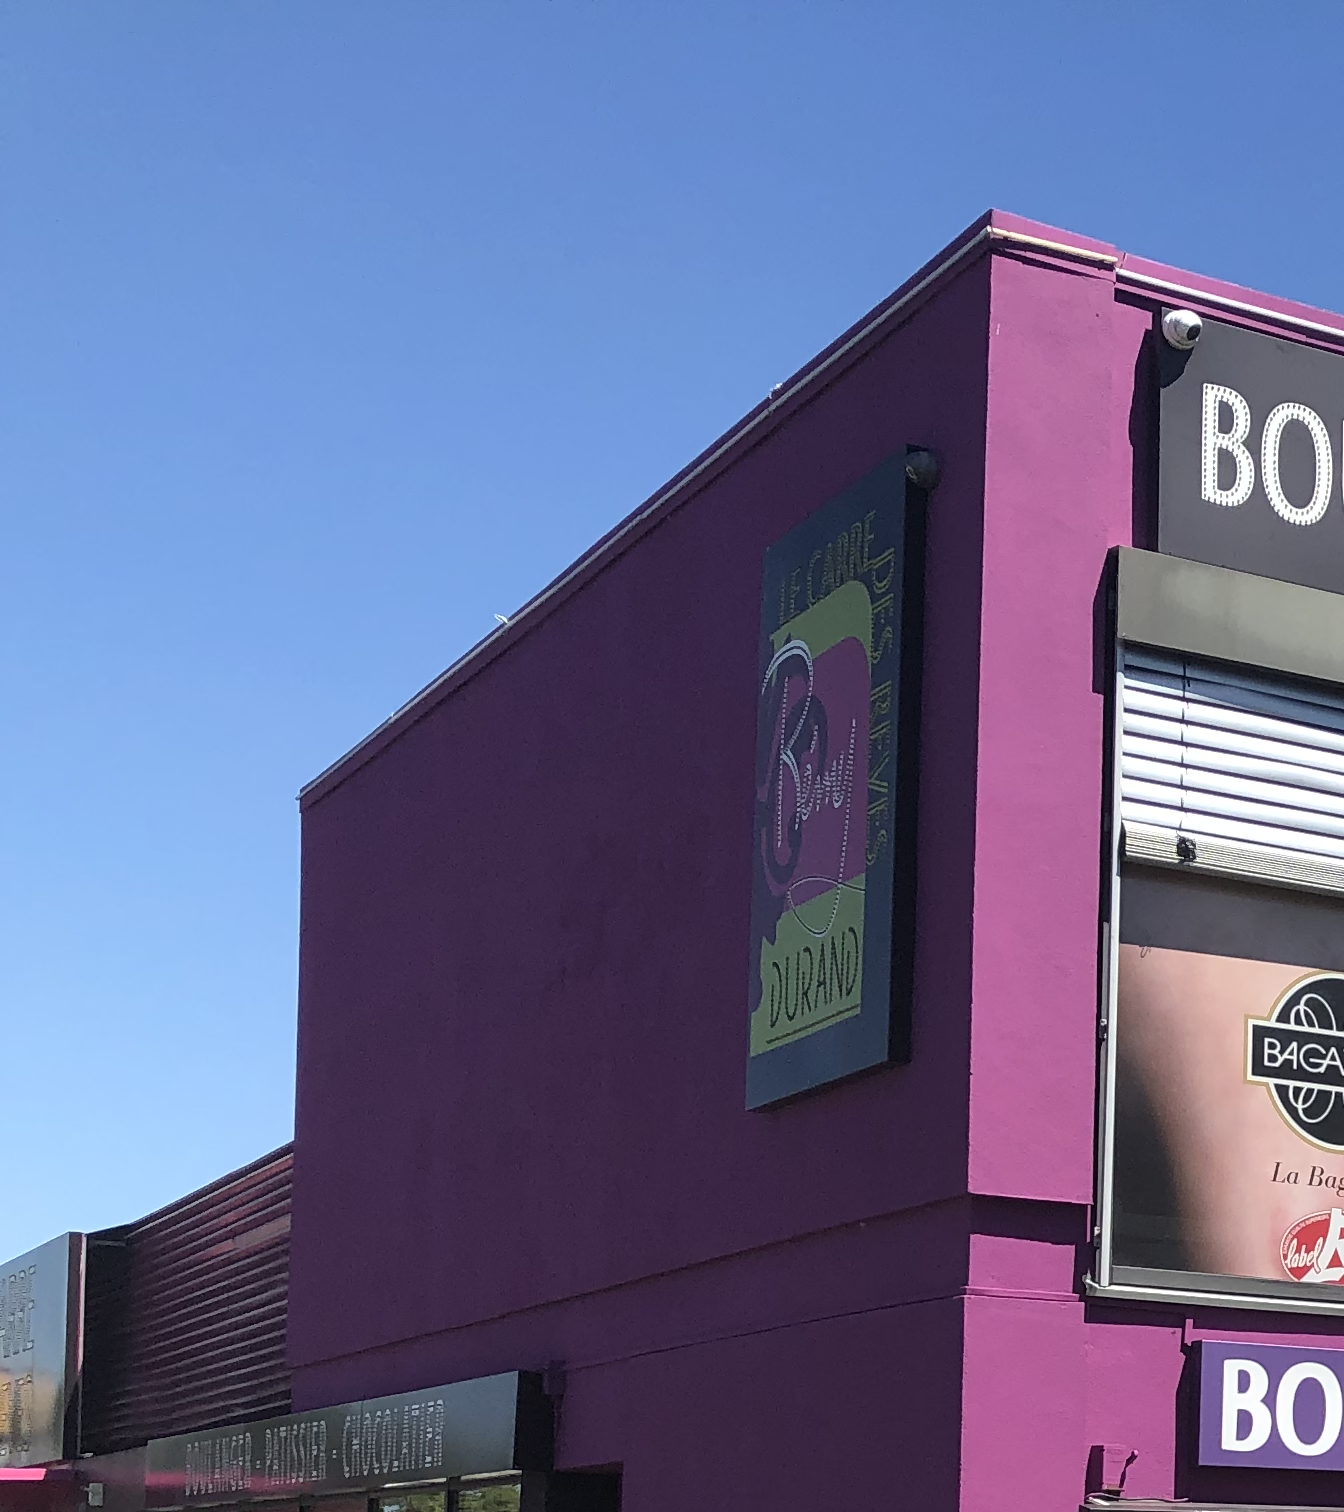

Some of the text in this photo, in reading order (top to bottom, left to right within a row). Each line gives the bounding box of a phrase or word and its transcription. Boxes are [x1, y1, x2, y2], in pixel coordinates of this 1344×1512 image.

[769, 926, 860, 1030] DURAND
[1271, 1162, 1299, 1184] La
[1285, 1237, 1323, 1274] label
[342, 1399, 445, 1478] CHOCOLATIER
